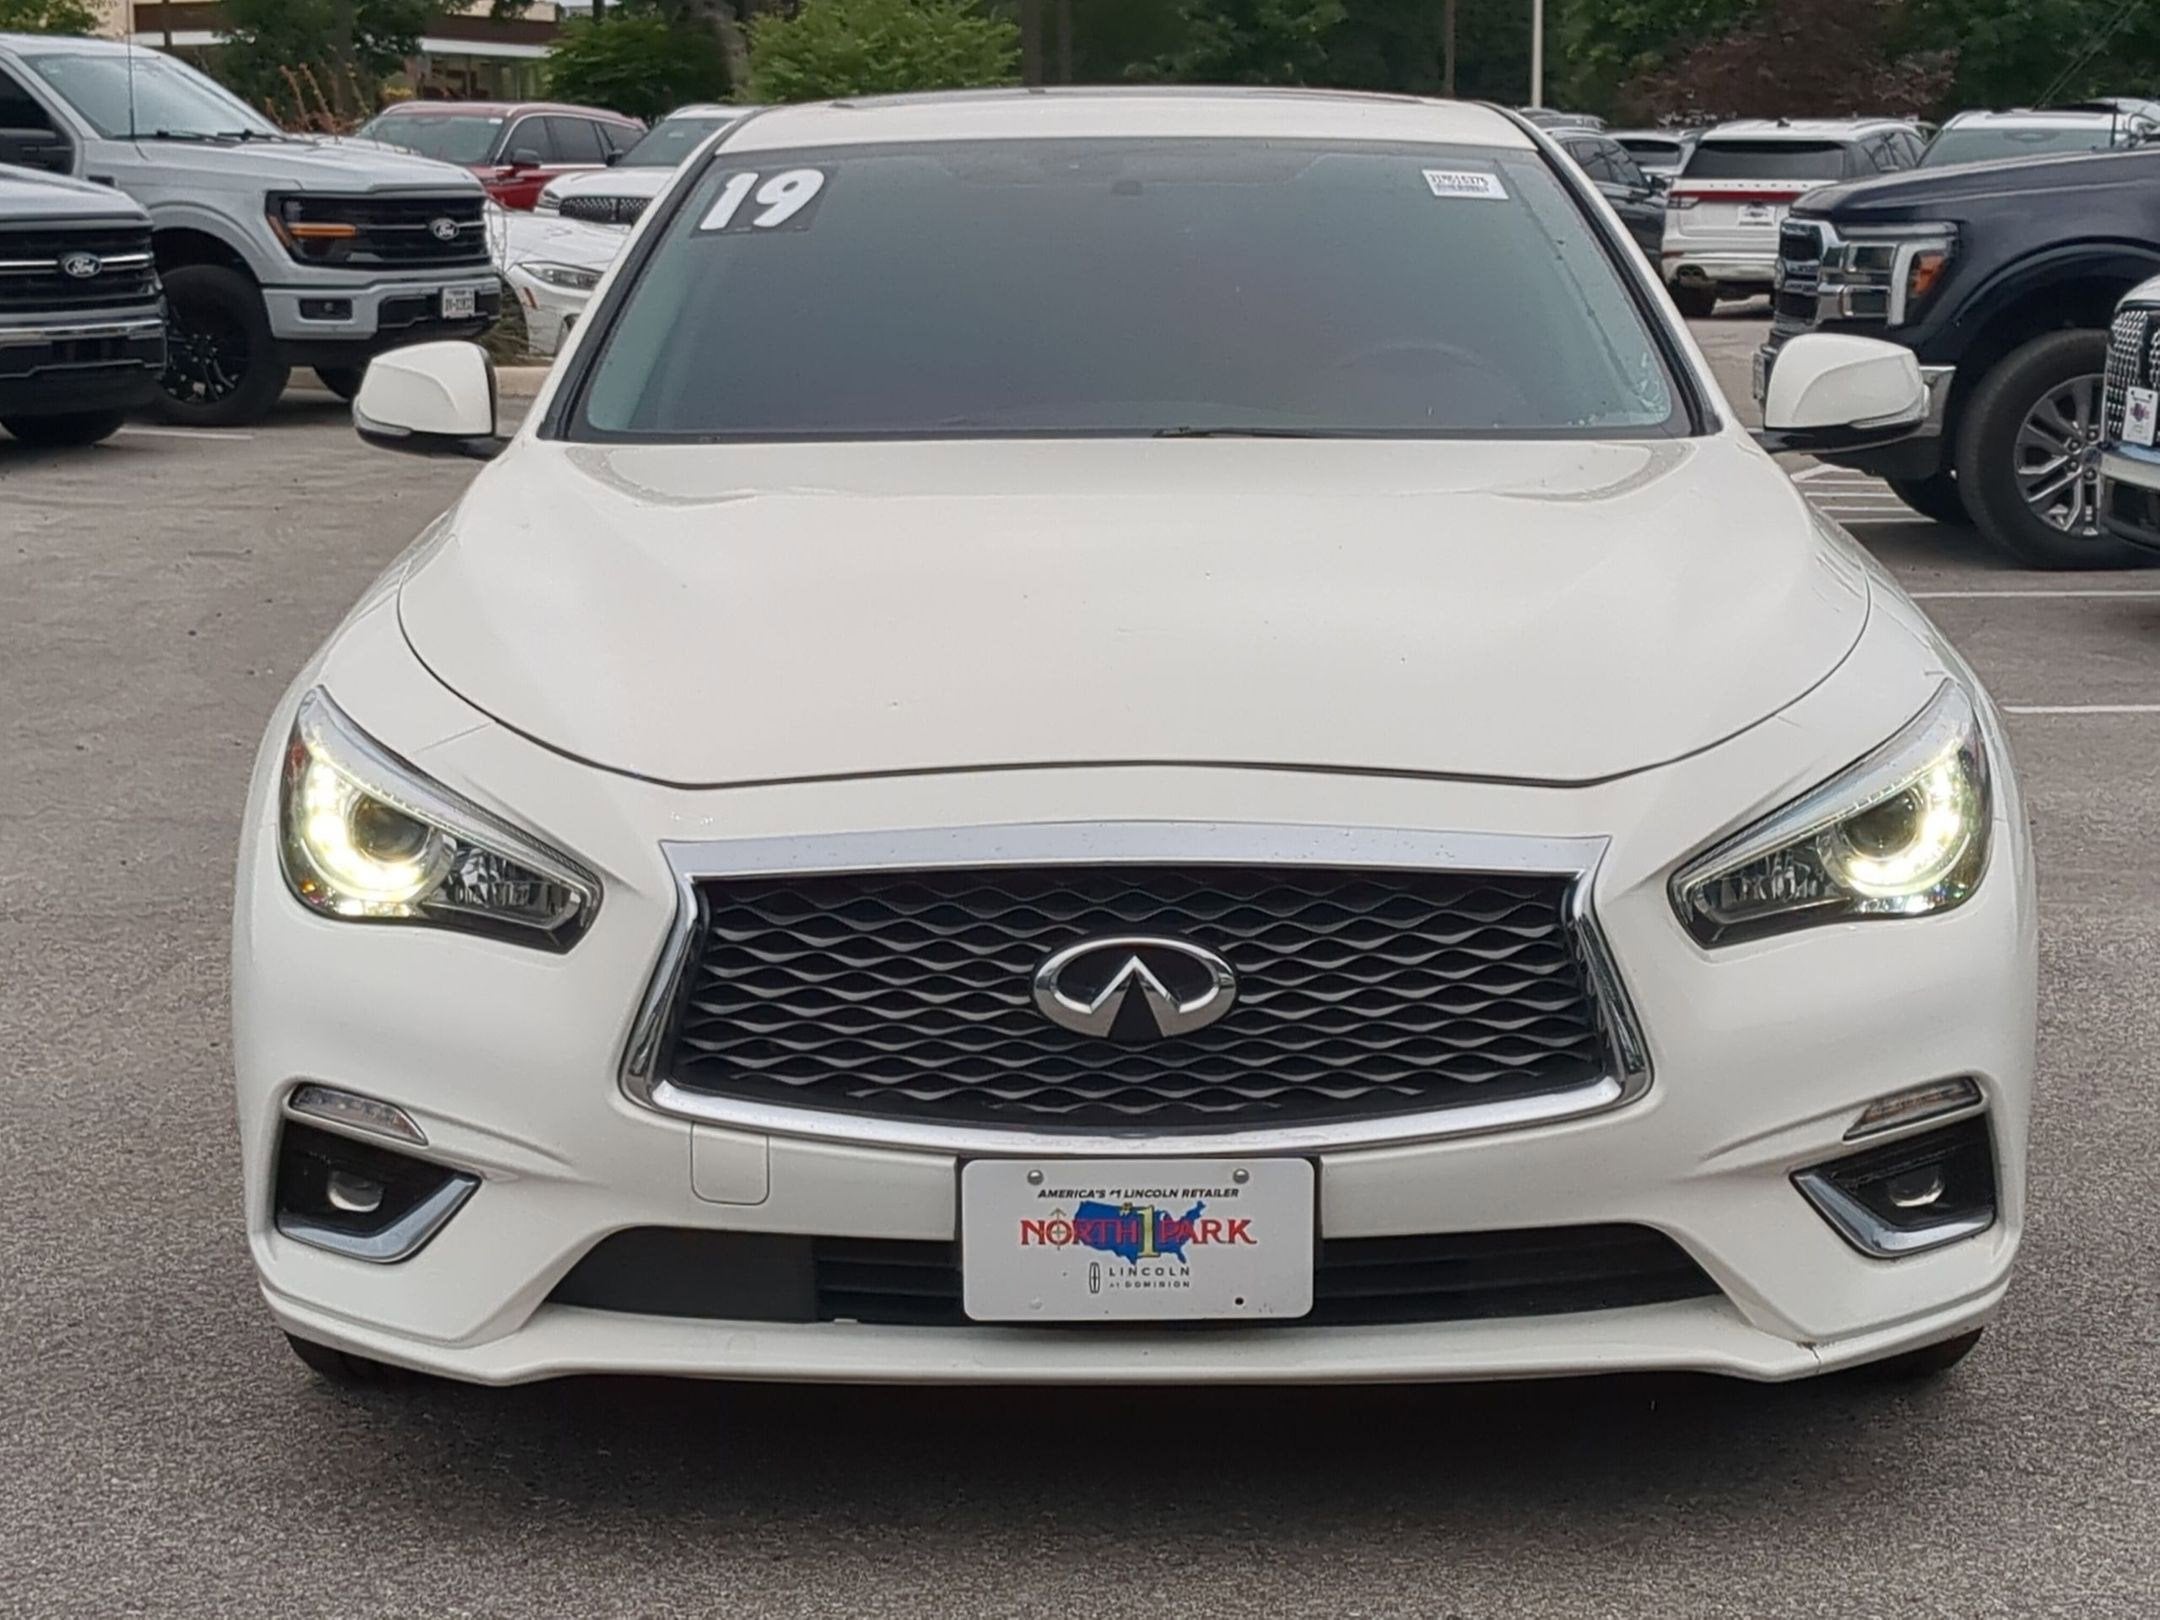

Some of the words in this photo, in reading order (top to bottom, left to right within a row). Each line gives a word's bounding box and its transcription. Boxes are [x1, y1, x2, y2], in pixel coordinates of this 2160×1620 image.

[700, 168, 825, 230] 19
[1037, 1189, 1106, 1199] AMERICA'S
[1124, 1188, 1179, 1199] LINCOLN
[1181, 1188, 1240, 1199] RETAILER
[1020, 1219, 1138, 1246] NORTH
[1160, 1218, 1258, 1246] PARK
[1108, 1266, 1190, 1277] LINCOLN
